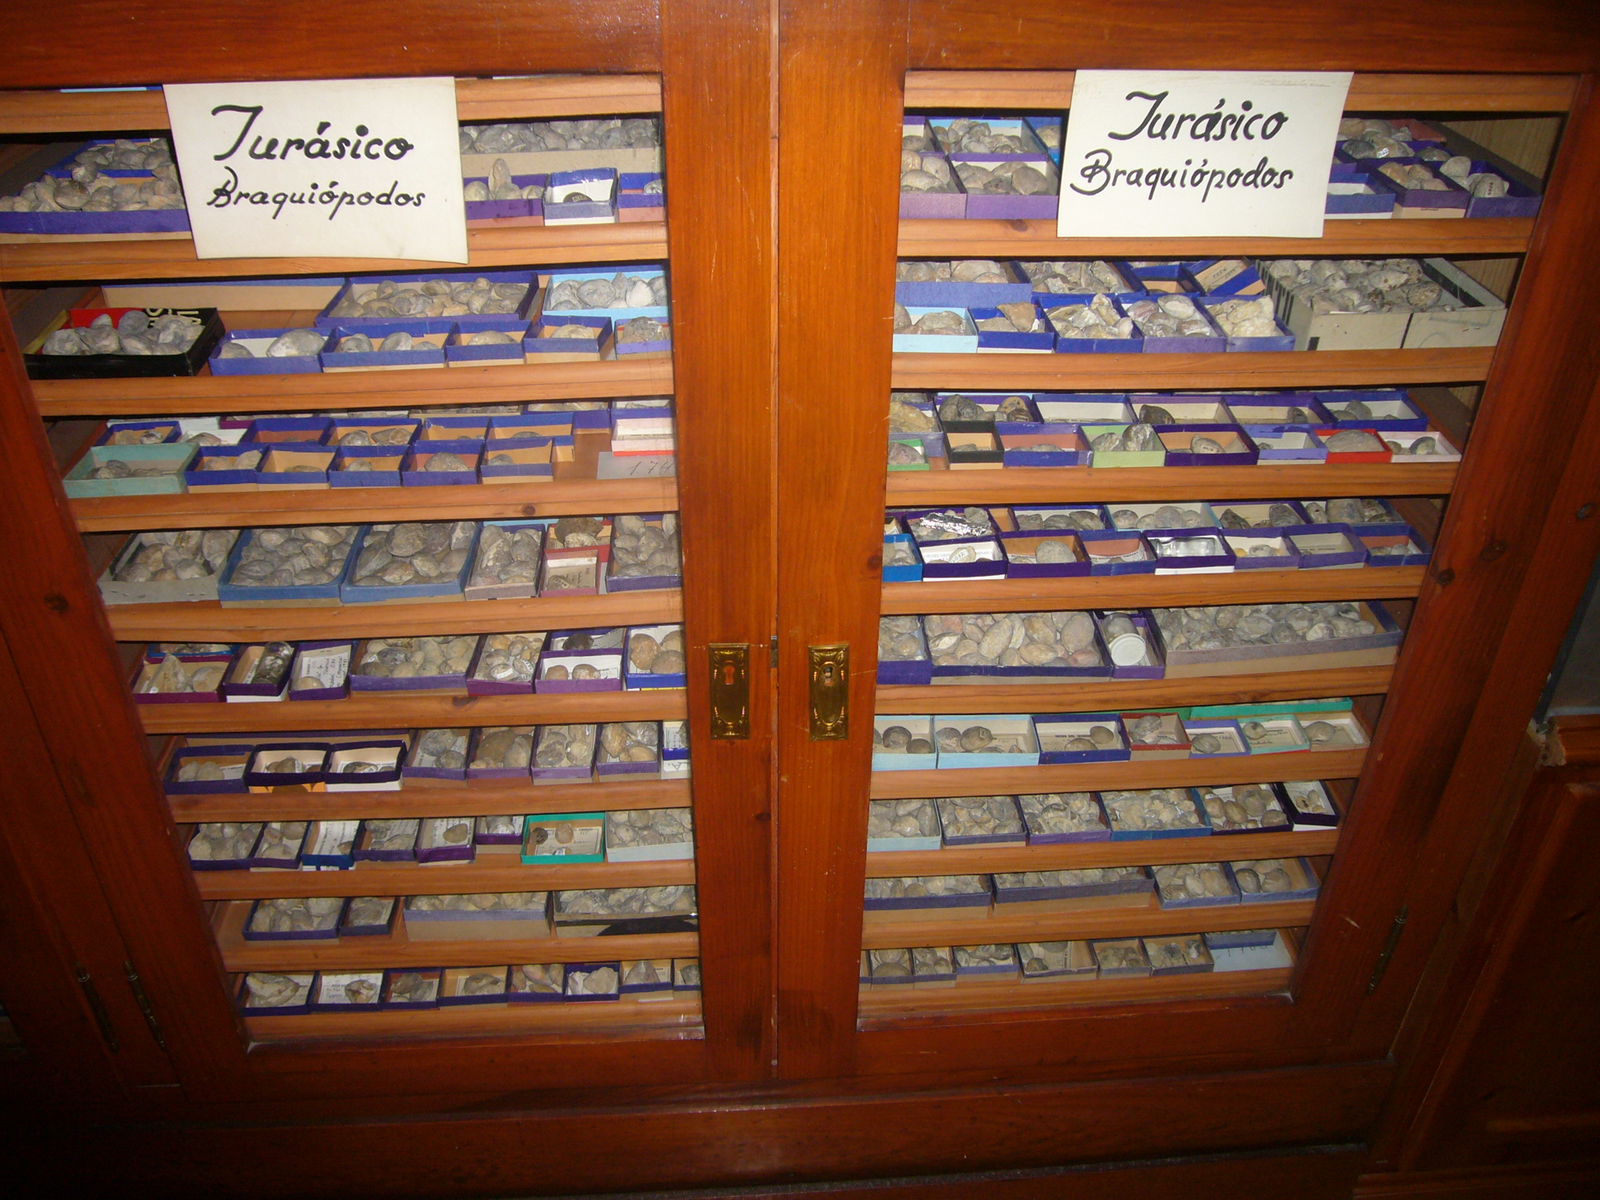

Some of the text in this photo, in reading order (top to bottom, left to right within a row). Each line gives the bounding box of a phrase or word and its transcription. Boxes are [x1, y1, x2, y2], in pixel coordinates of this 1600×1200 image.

[211, 104, 415, 161] Jurásico
[1108, 91, 1289, 142] Jurásico
[207, 165, 426, 220] Braquiópodos
[1070, 148, 1294, 203] Braquiópodos
